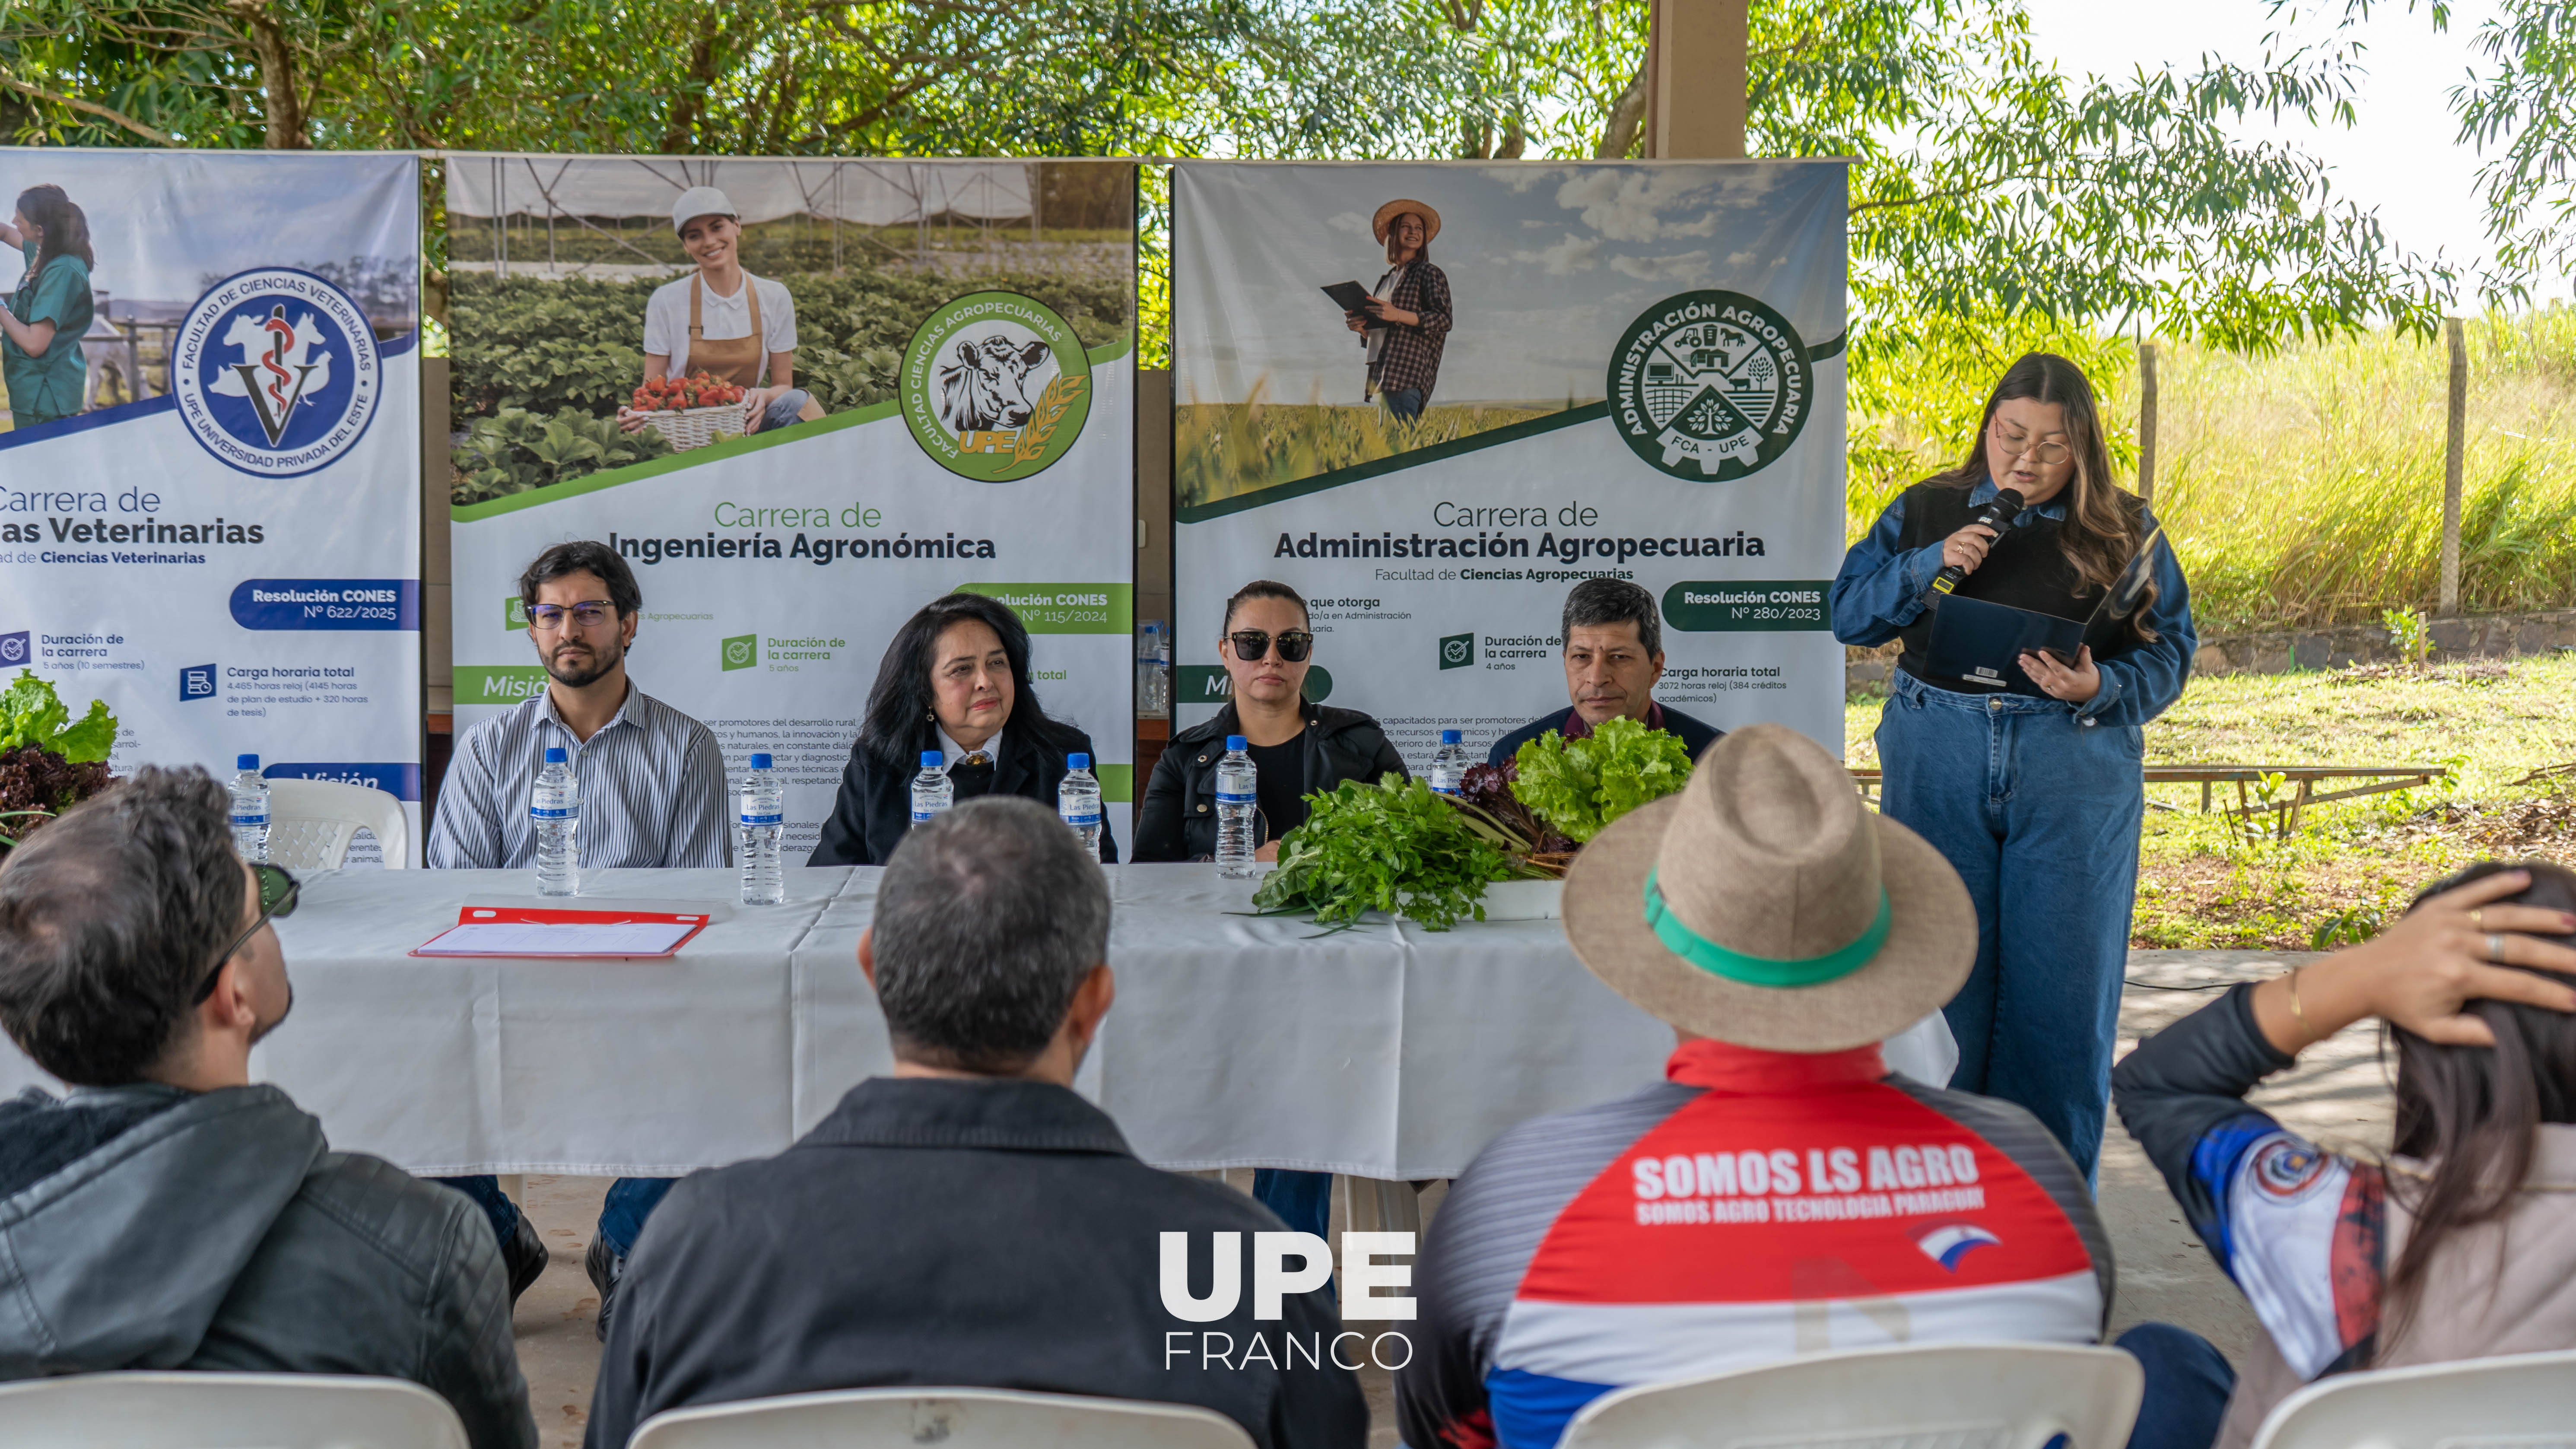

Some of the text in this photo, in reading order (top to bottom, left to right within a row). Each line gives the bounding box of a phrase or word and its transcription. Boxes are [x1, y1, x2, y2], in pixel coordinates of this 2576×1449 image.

[183, 277, 371, 371] FACULTAD DE CIENCIAS VETERINARIAS
[1619, 302, 1801, 435] ADMINISTRACIÓN AGROPECUARIA
[911, 302, 1062, 459] FACULTAD CIENCIAS AGROPECUARIAS
[185, 392, 368, 468] UPE UNIVERSIDAD PRIVADA DEL ESTE
[959, 431, 1016, 454] UPE
[1671, 436, 1699, 453] FCA
[1719, 435, 1750, 453] UPE
[119, 486, 160, 512] de
[714, 502, 882, 528] Carrera de
[1434, 500, 1598, 527] Carrera de
[48, 518, 264, 544] Veterinarias
[610, 532, 996, 566] Ingeniería Agronómica
[1274, 531, 1765, 564] Administración Agropecuaria
[17, 551, 36, 563] de
[41, 551, 108, 564] Ciencias
[111, 552, 205, 564] Veterinarias
[1375, 568, 1633, 582] Facultad de Ciencias Agropecuarias
[253, 589, 396, 602] Resolución CONES
[992, 594, 1107, 606] olución CONES
[1685, 591, 1820, 604] Resolución CONES
[1311, 599, 1380, 610] que otorga
[327, 605, 396, 620] 622/2025
[648, 612, 713, 621] Agropecuarias
[1045, 609, 1107, 623] 115/2024
[1345, 611, 1411, 620] Administración
[1753, 607, 1820, 620] 280/2023
[42, 634, 124, 644] Duración de
[768, 637, 845, 648] Duración de
[1485, 635, 1562, 646] Duración de
[42, 647, 107, 656] la carrera
[768, 650, 830, 660] la carrera
[1485, 648, 1547, 658] la carrera
[51, 661, 74, 669] años
[78, 661, 89, 670] (10
[93, 661, 145, 670] semestres)
[227, 667, 354, 679] Carga horaria total
[1038, 670, 1066, 680] total
[1661, 666, 1780, 680] Carga horaria total
[283, 682, 302, 691] reloj
[305, 682, 329, 691] (4145
[483, 676, 547, 696] Misió
[1709, 681, 1727, 691] reloj
[1729, 681, 1749, 690] (384
[1752, 681, 1787, 690] créditos
[241, 696, 262, 705] plan
[1658, 693, 1717, 703] académicos)
[241, 708, 266, 718] tesis)
[719, 719, 770, 728] promotores
[1383, 716, 1436, 725] capacitados
[1476, 716, 1526, 725] promotores
[737, 730, 780, 739] humanos,
[793, 730, 840, 738] innovación
[802, 753, 852, 763] diagnostica
[792, 777, 842, 786] respetando
[1633, 1144, 1979, 1199] SOMOS LS AGRO
[1636, 1187, 1985, 1225] SOMOS AGRO TECNOLOGIA PARAGUAY
